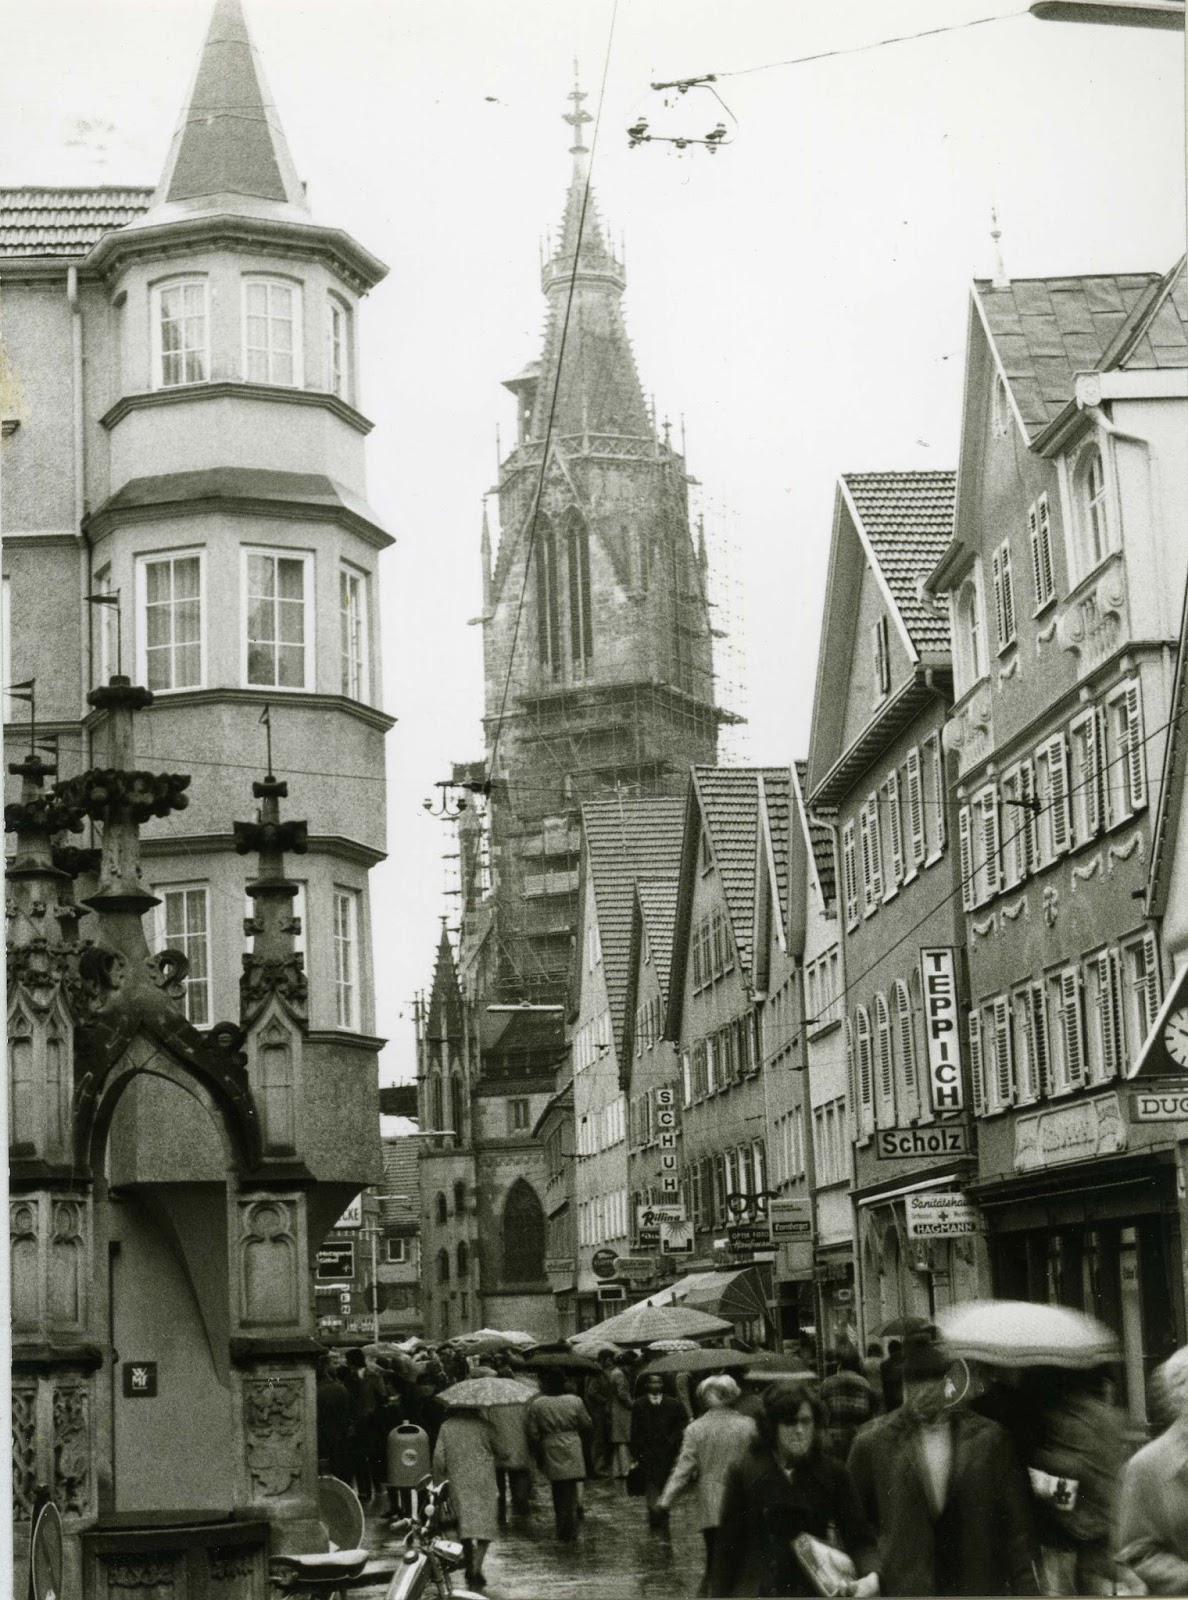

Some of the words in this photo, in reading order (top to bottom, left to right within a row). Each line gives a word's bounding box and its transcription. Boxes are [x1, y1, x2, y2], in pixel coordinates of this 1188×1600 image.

[926, 952, 959, 1106] TEPPICH
[660, 1091, 676, 1190] SCHUH
[882, 1129, 961, 1154] Scholz
[917, 1222, 973, 1234] HAGMANN
